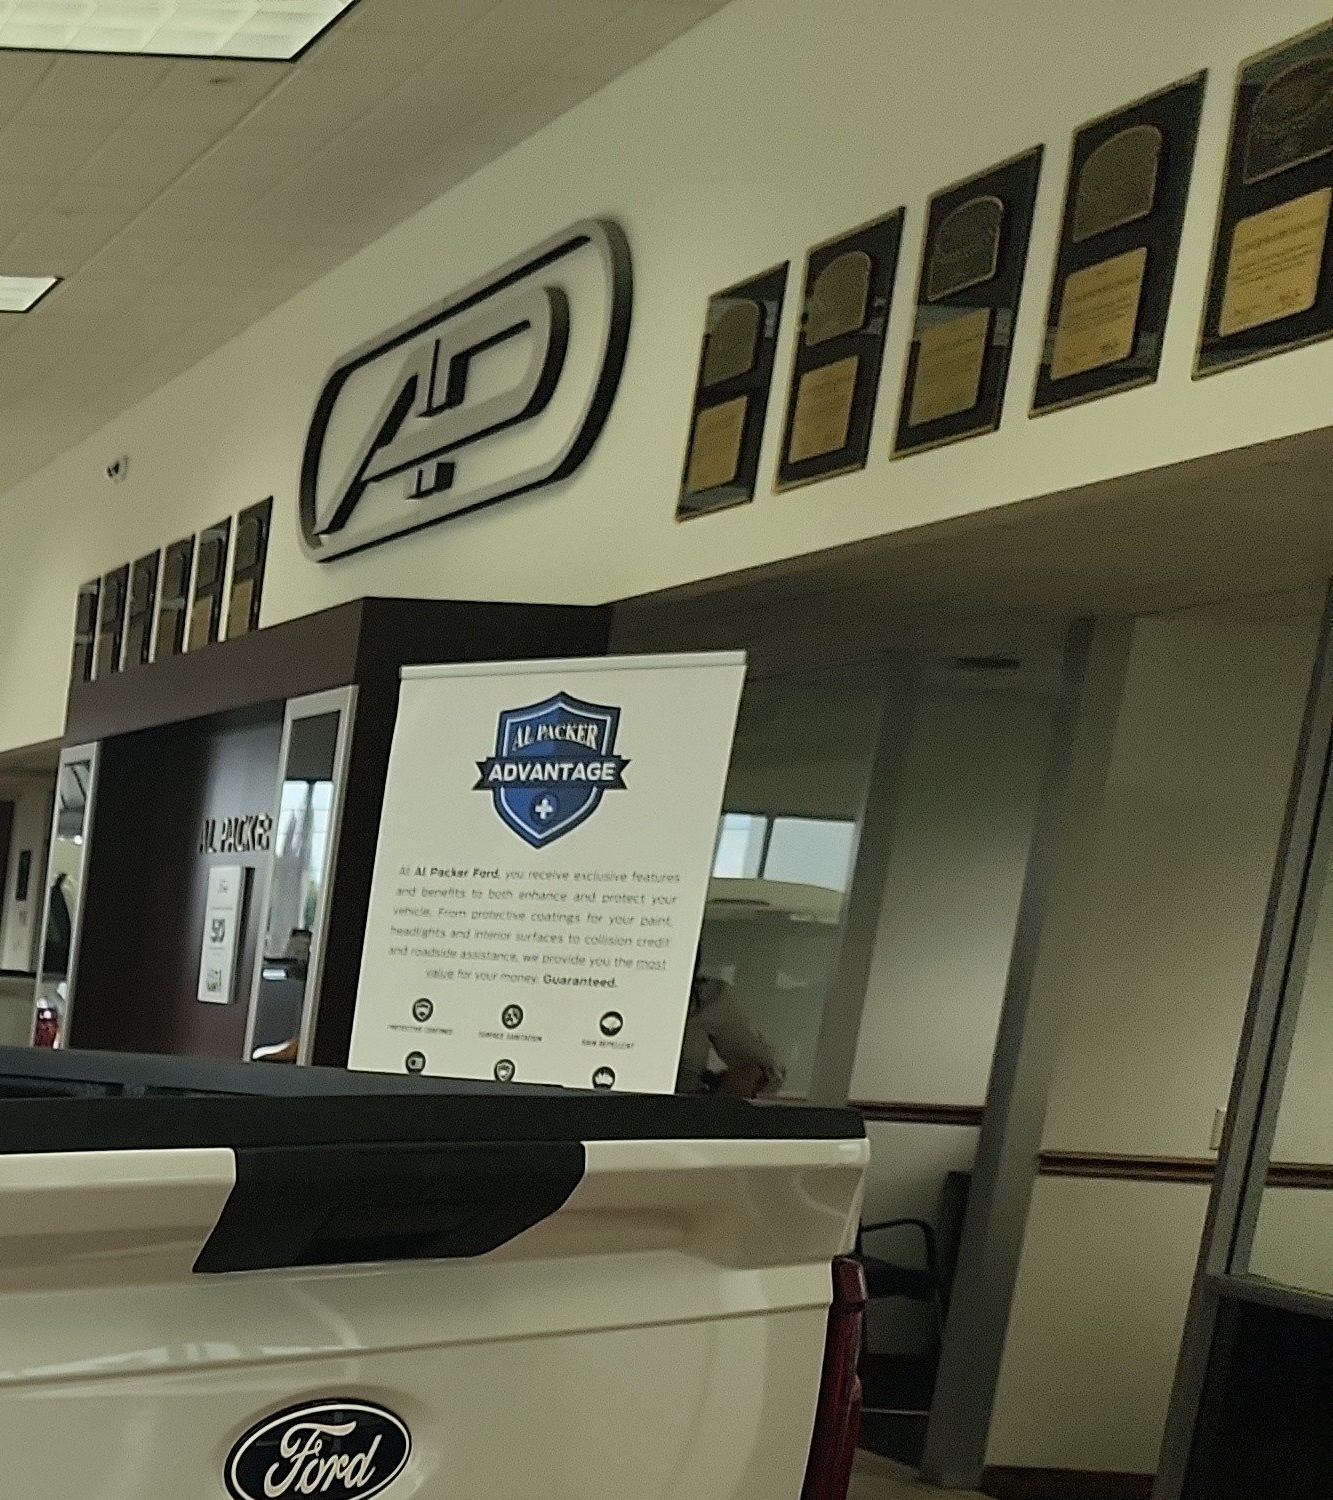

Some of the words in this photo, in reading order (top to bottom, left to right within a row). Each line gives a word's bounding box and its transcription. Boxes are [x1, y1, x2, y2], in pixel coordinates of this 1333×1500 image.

[512, 724, 533, 750] AL
[536, 722, 599, 750] PACKER
[488, 762, 616, 782] ADVANTAGE
[430, 867, 468, 878] Packer
[505, 871, 524, 881] you
[528, 870, 569, 881] receive
[574, 871, 627, 883] exclusive
[632, 871, 680, 884] features
[395, 886, 416, 898] and
[421, 886, 465, 900] benefits
[471, 889, 483, 900] to
[488, 888, 513, 900] both
[518, 889, 567, 902] enhance
[574, 892, 596, 903] and
[602, 893, 645, 905] protect
[652, 895, 676, 907] your
[438, 907, 466, 918] From
[471, 910, 526, 922] protective
[530, 912, 580, 925] coatings
[586, 912, 603, 924] for
[609, 915, 634, 927] your
[450, 928, 472, 939] and
[515, 931, 564, 944] surfaces
[568, 933, 581, 944] to
[584, 934, 633, 947] collision
[388, 945, 408, 957] and
[542, 954, 586, 967] provide
[589, 957, 611, 968] you
[614, 956, 634, 968] the
[542, 974, 618, 988] Guaranteed.
[264, 1420, 382, 1498] Ford
